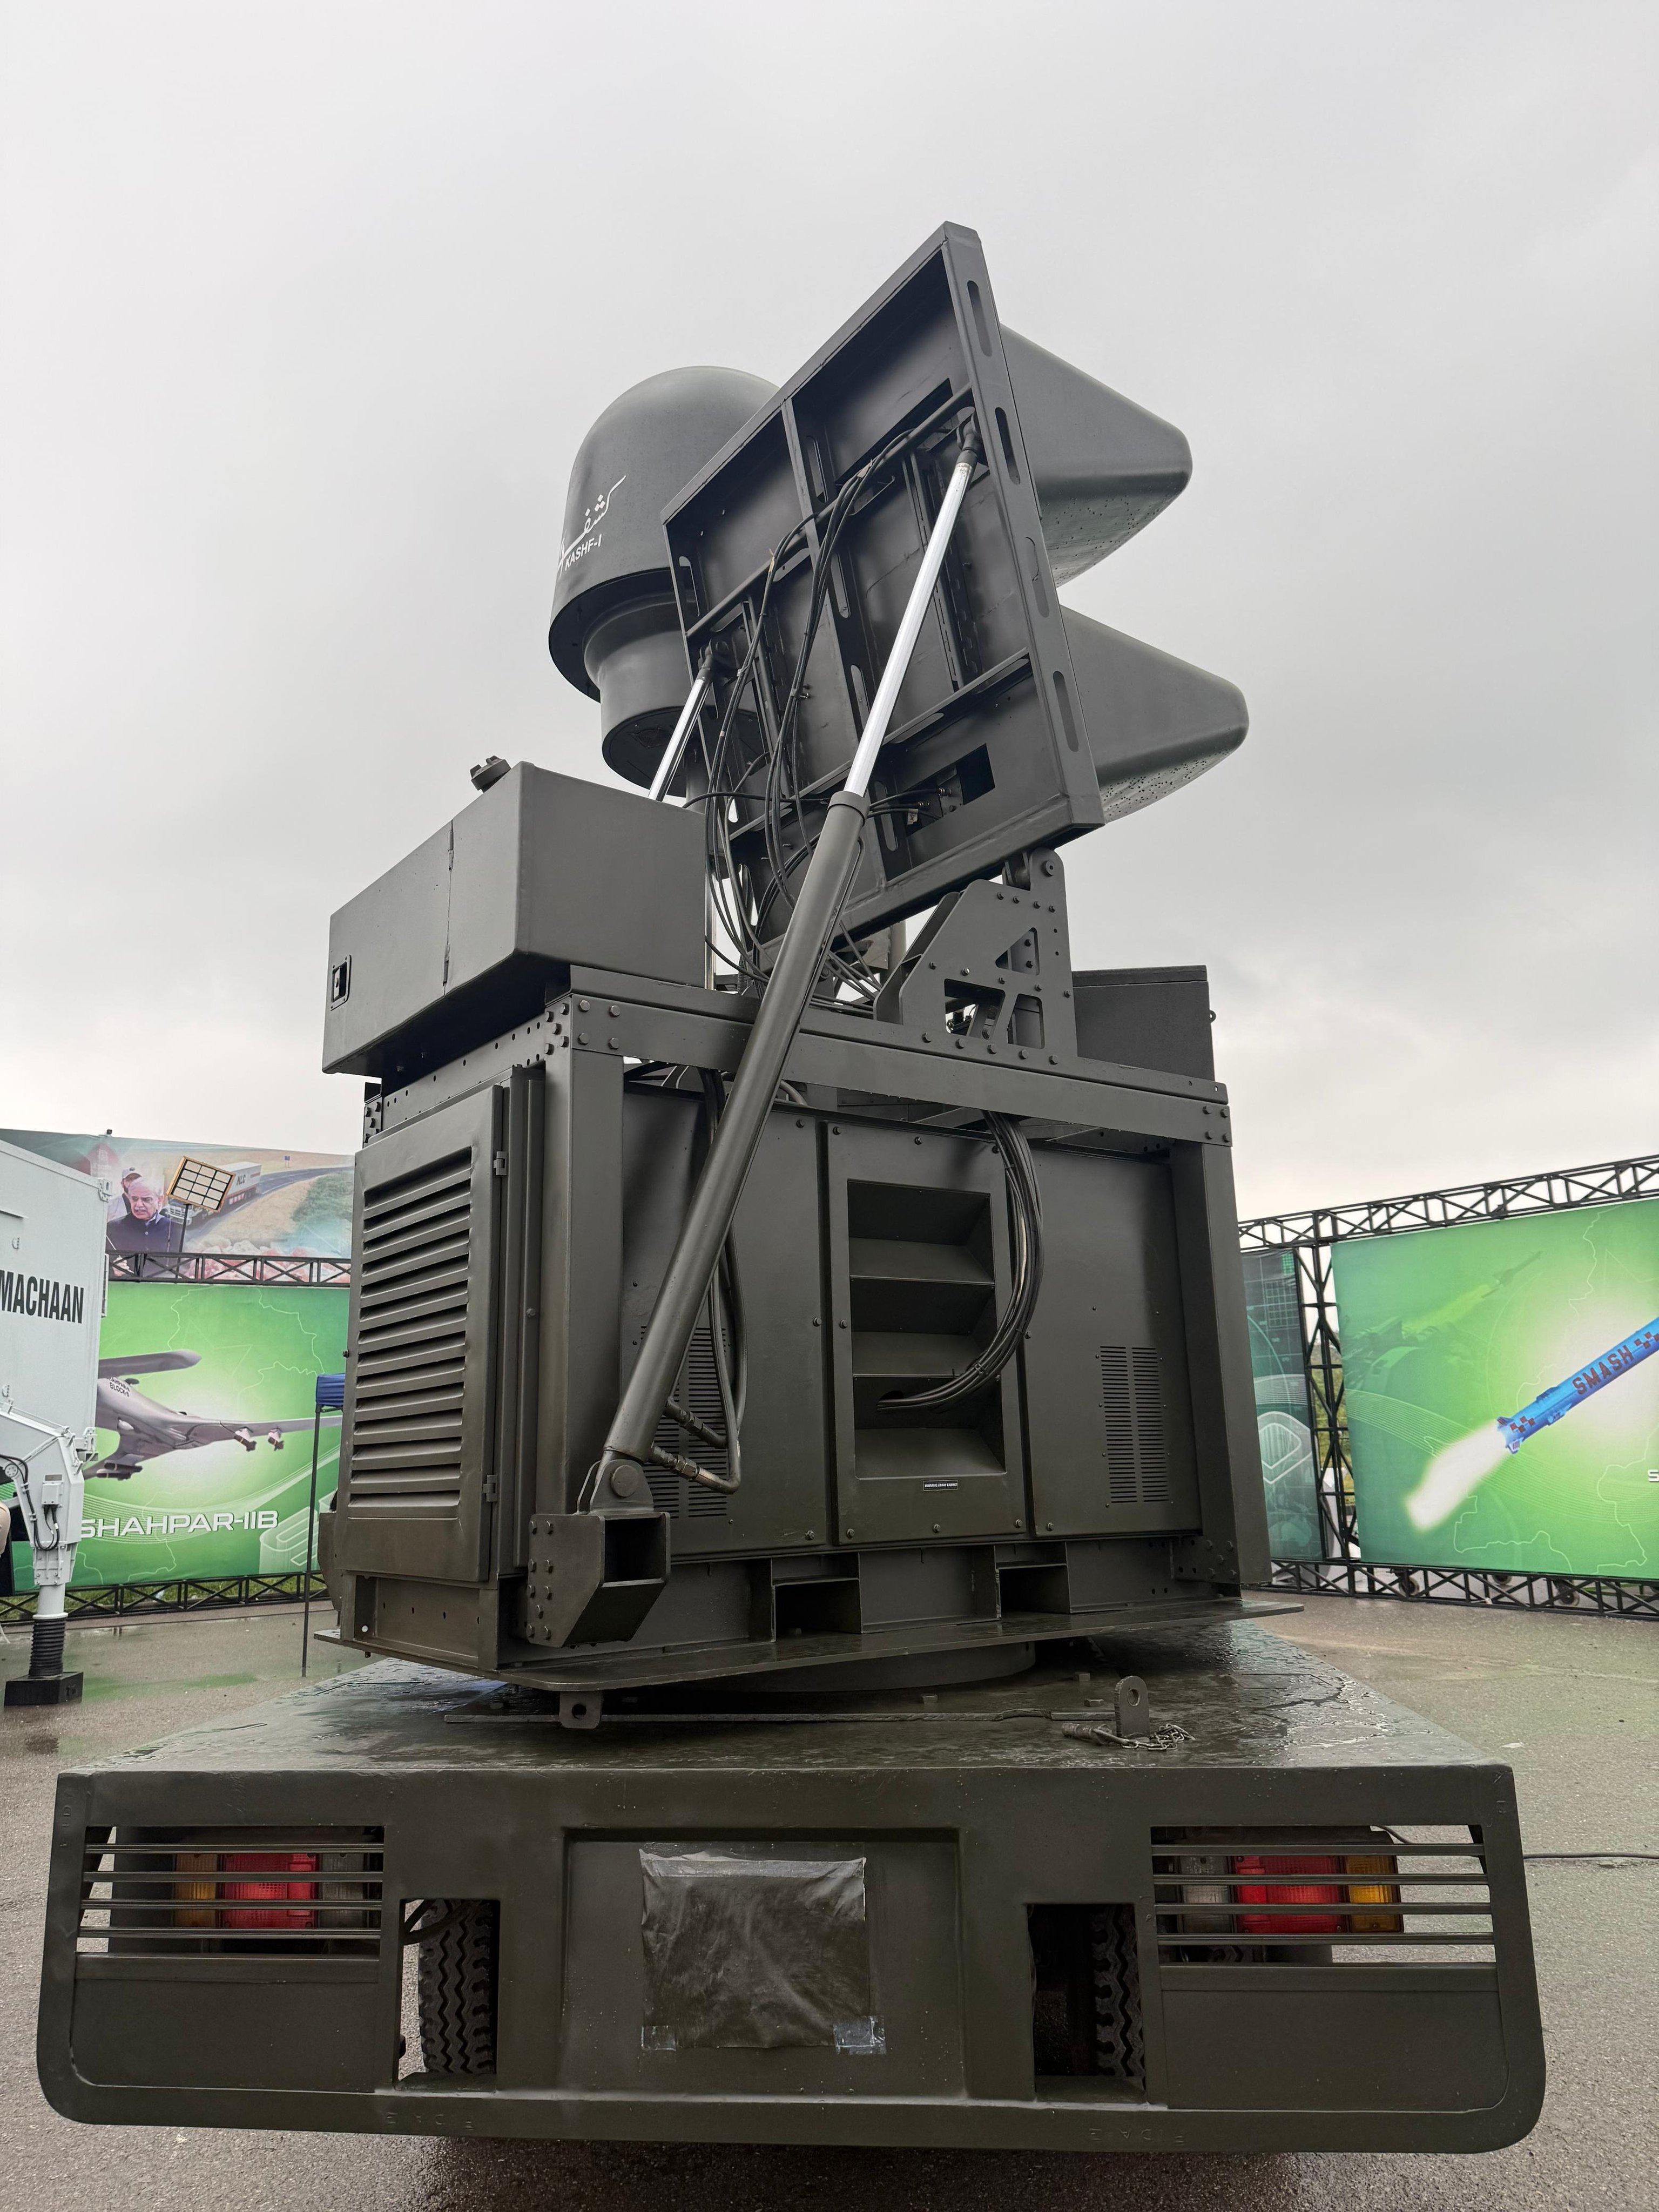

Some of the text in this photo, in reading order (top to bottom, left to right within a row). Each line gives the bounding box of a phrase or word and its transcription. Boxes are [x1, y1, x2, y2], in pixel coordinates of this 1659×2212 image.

[565, 534, 602, 571] KASHF-I
[0, 1270, 84, 1324] MACHAAN
[1572, 1345, 1634, 1395] SMASH
[81, 1510, 278, 1538] SHAHPAR-IIB
